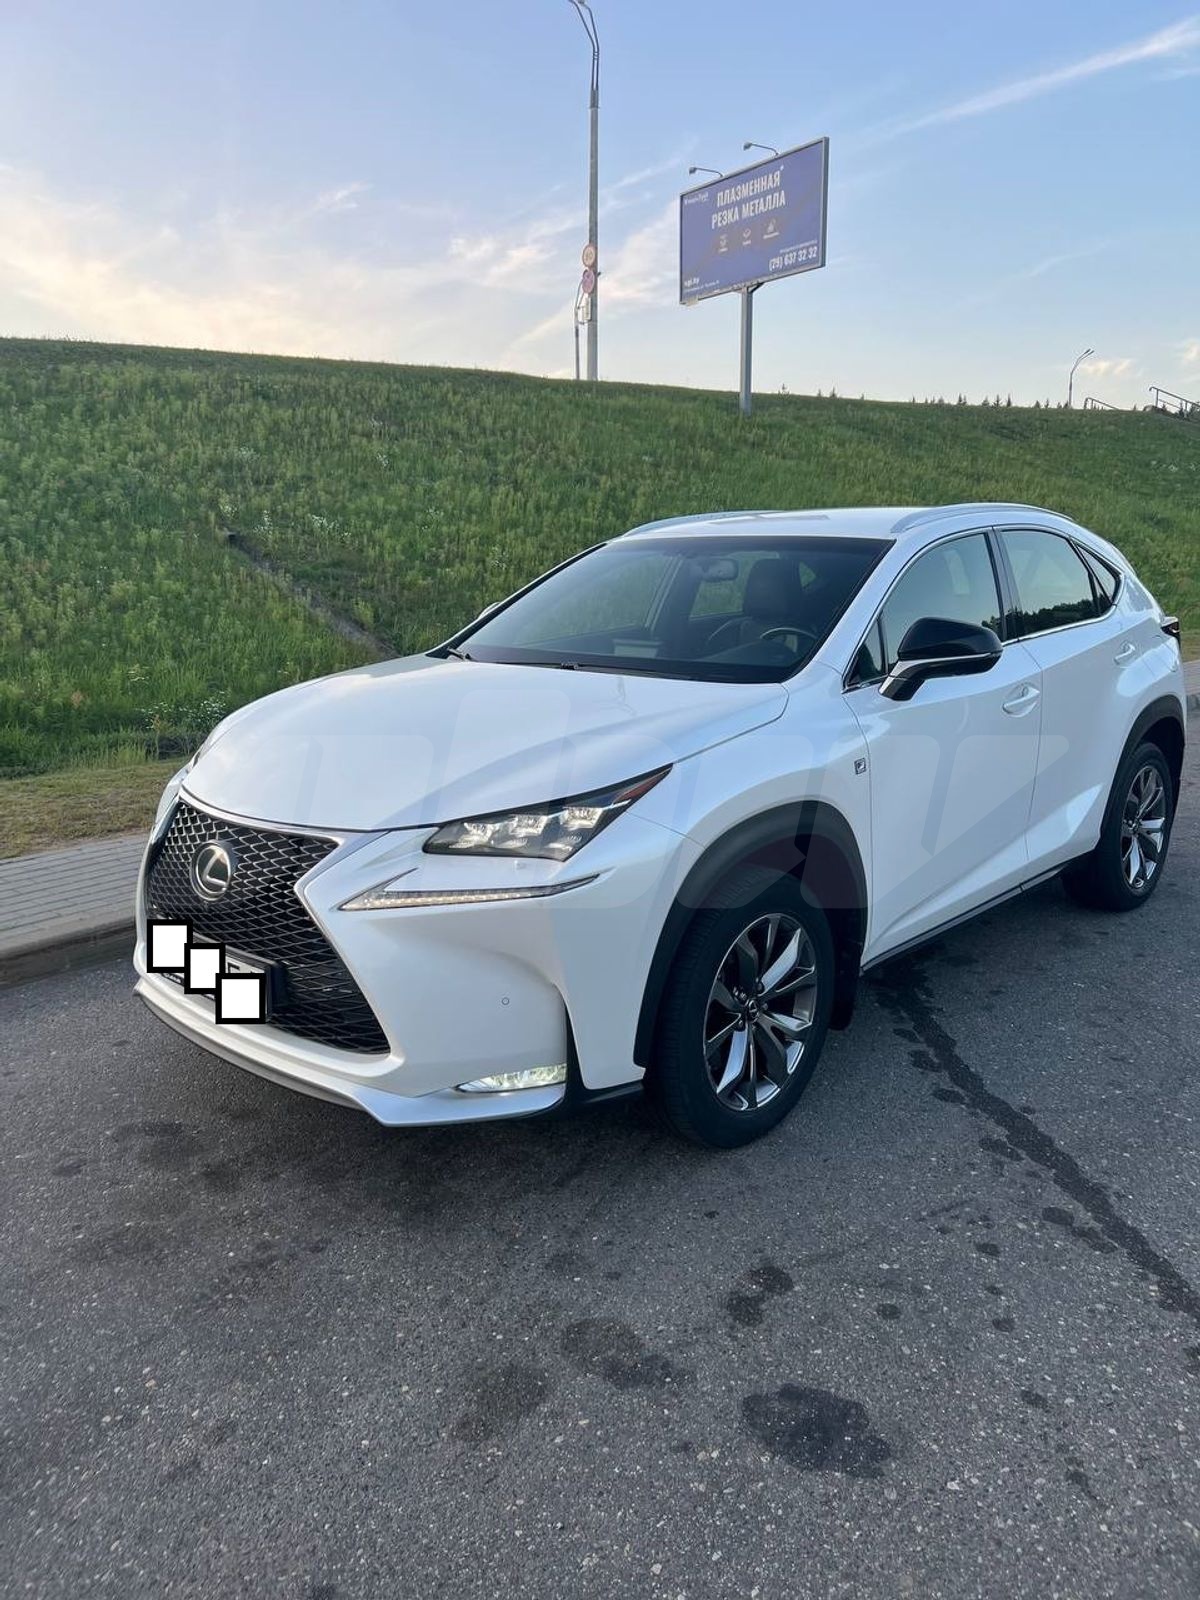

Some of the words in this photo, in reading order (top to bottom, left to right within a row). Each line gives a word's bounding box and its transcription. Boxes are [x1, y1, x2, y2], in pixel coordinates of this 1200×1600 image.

[717, 170, 781, 209] ПЛАЗМЕННАЯ
[711, 206, 740, 229] РЕЗКА
[741, 190, 786, 217] МЕТАЛЛА
